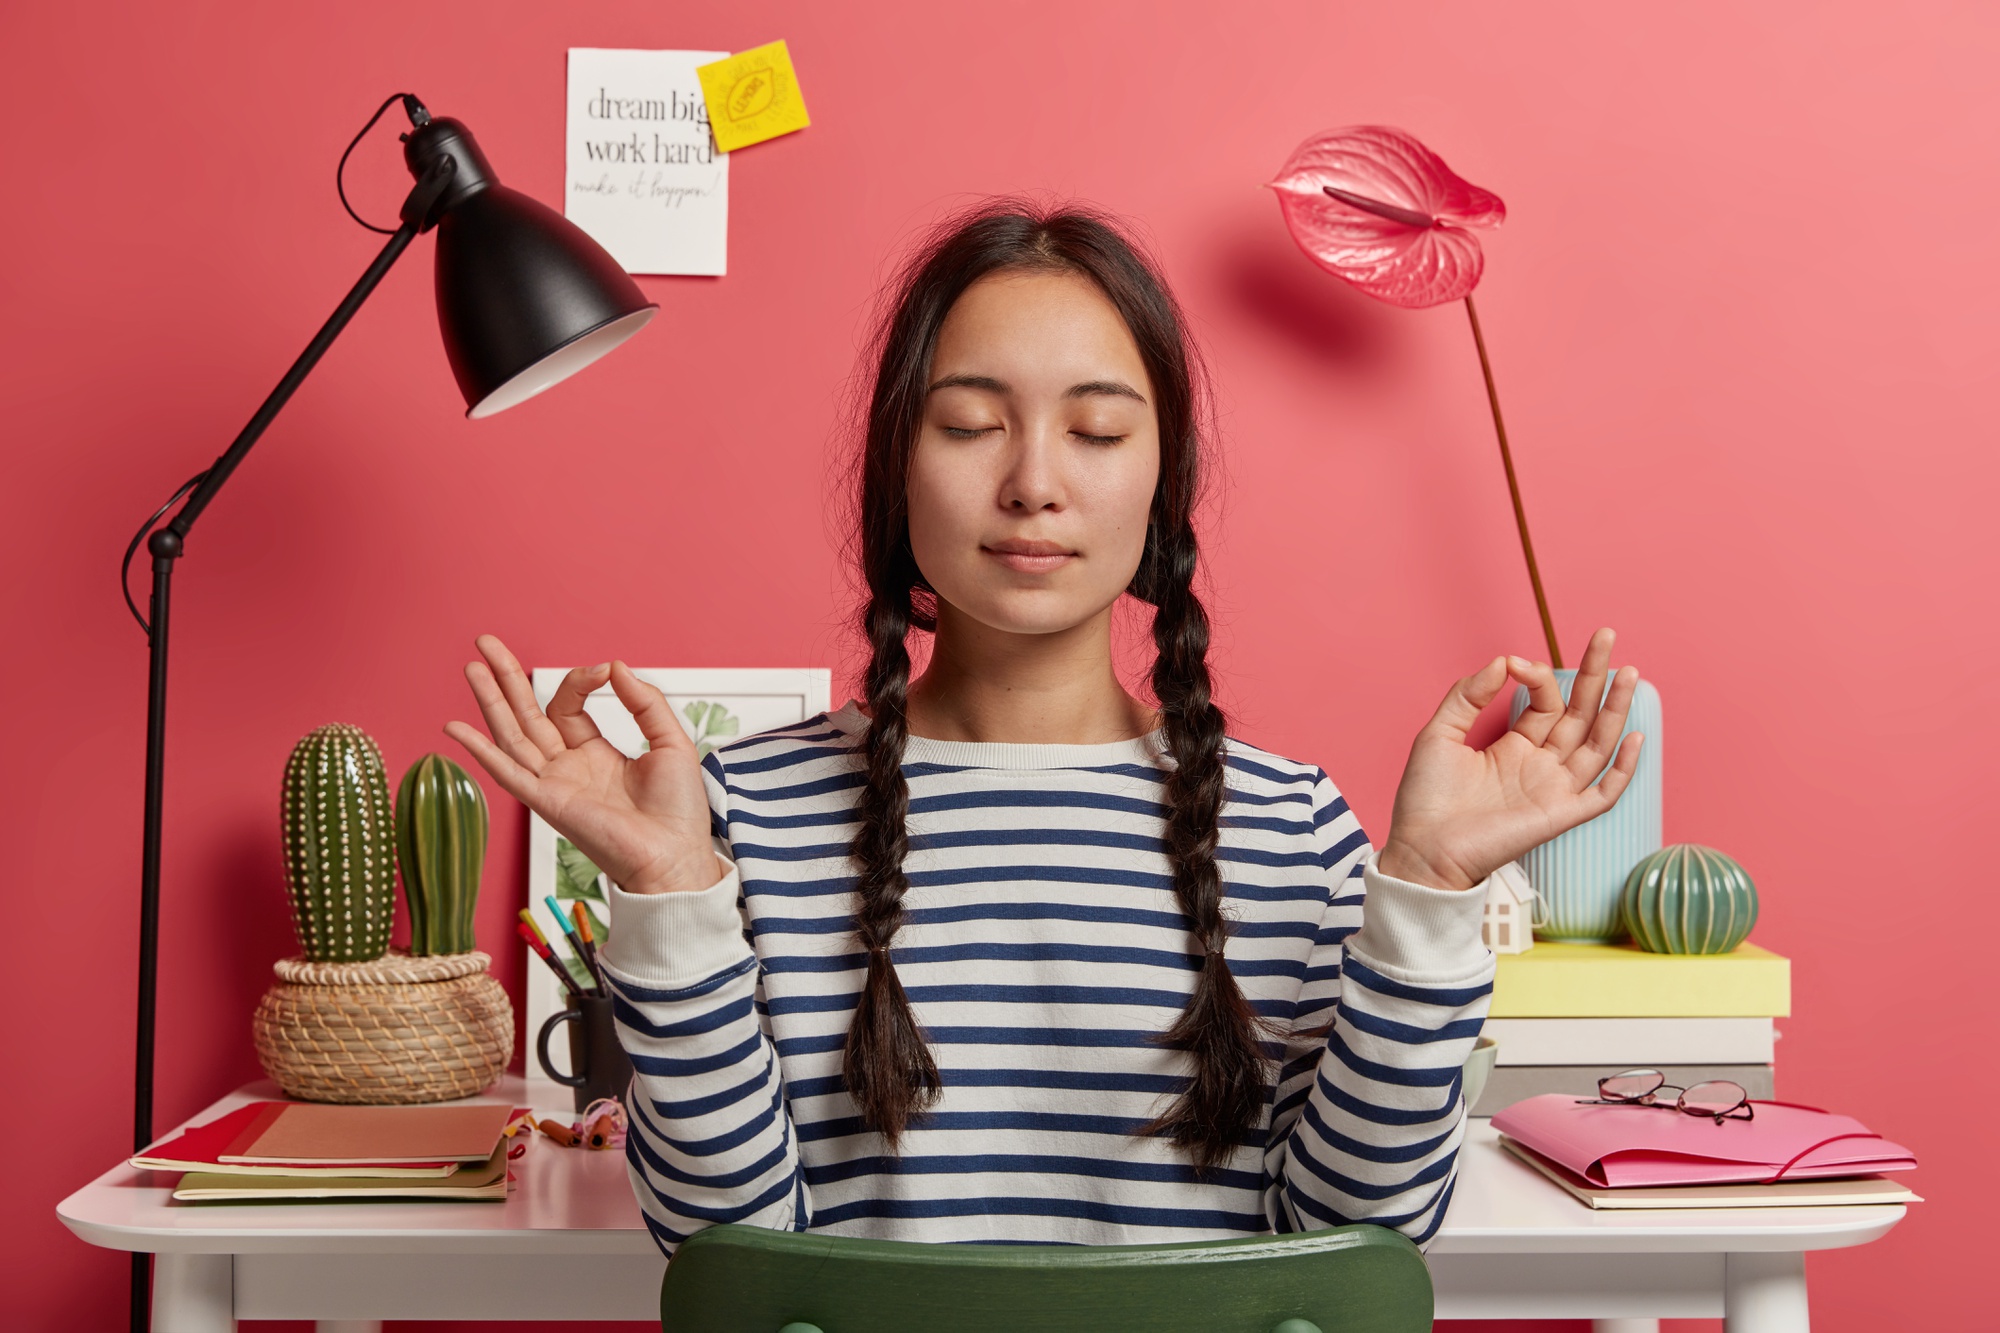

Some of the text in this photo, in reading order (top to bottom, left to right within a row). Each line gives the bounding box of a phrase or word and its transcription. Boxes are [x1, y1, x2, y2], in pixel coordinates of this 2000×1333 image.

[587, 87, 666, 121] dream
[671, 90, 713, 134] big
[585, 132, 714, 165] work hard
[573, 172, 618, 195] make
[627, 169, 647, 199] it
